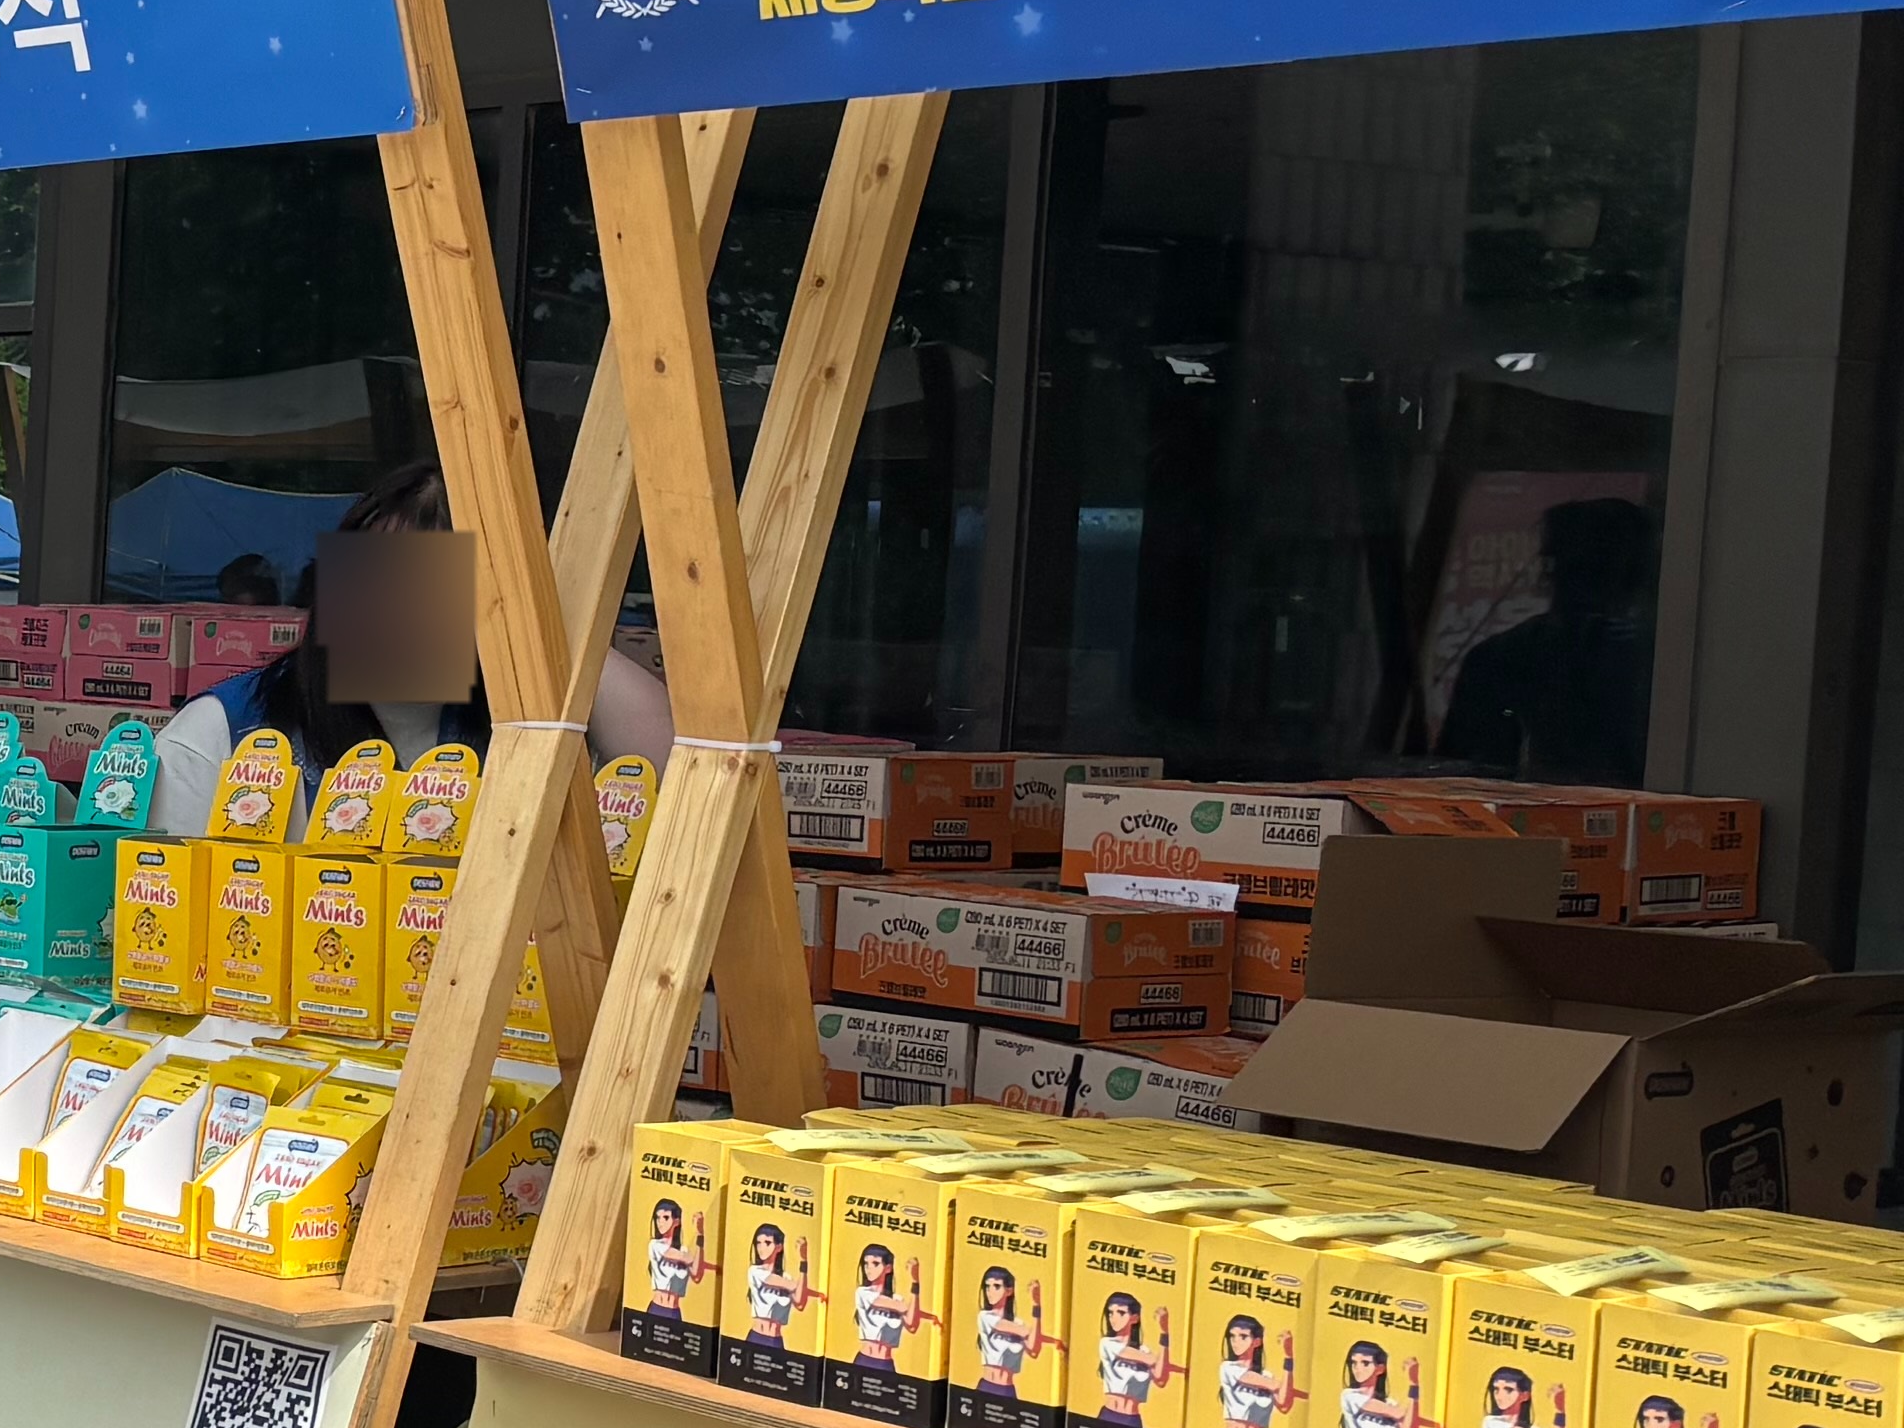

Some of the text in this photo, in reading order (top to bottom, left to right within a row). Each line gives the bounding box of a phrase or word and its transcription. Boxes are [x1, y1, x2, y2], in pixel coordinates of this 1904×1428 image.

[65, 723, 100, 740] Cream
[95, 751, 147, 778] Mints
[228, 762, 284, 789] Mints
[404, 773, 468, 801] Mints
[1, 786, 45, 815] Mints
[1120, 809, 1179, 836] Crème
[1266, 828, 1317, 844] 44466
[124, 880, 178, 909] Mints
[304, 900, 366, 928] Mints
[881, 914, 930, 940] Crème
[49, 939, 90, 959] Mints
[1017, 939, 1063, 957] 44466
[900, 1046, 944, 1063] 44466
[1180, 1103, 1234, 1124] 44466
[642, 1153, 686, 1169] STATIC
[641, 1165, 711, 1191] 스태틱 부스터
[290, 1220, 339, 1241] Mints
[1331, 1285, 1393, 1307] STATIC
[1328, 1300, 1428, 1335] 스태틱 부스터
[1617, 1337, 1689, 1360] STATIC
[1615, 1354, 1728, 1389] 스태틱 부스터
[1769, 1363, 1842, 1388] STATIC
[1767, 1380, 1883, 1419] 스태틱 부스터
